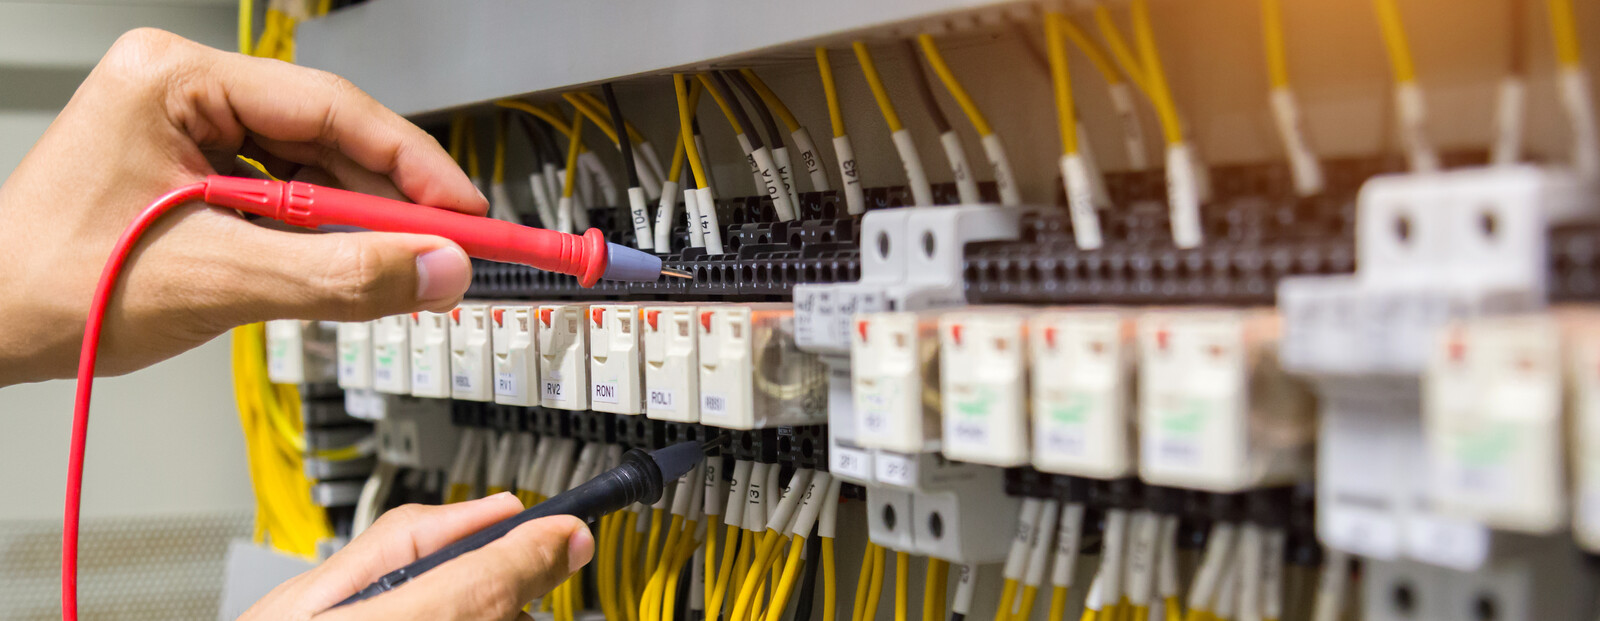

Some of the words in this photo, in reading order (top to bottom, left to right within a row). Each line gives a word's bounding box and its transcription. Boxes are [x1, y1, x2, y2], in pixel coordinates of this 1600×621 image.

[843, 160, 860, 185] 143
[762, 168, 780, 200] 101A
[633, 208, 647, 231] 104
[700, 214, 711, 235] 141
[499, 379, 512, 391] RV1
[547, 383, 561, 396] RV2
[596, 384, 615, 398] RON1
[651, 391, 672, 405] ROL1
[749, 483, 760, 504] 131
